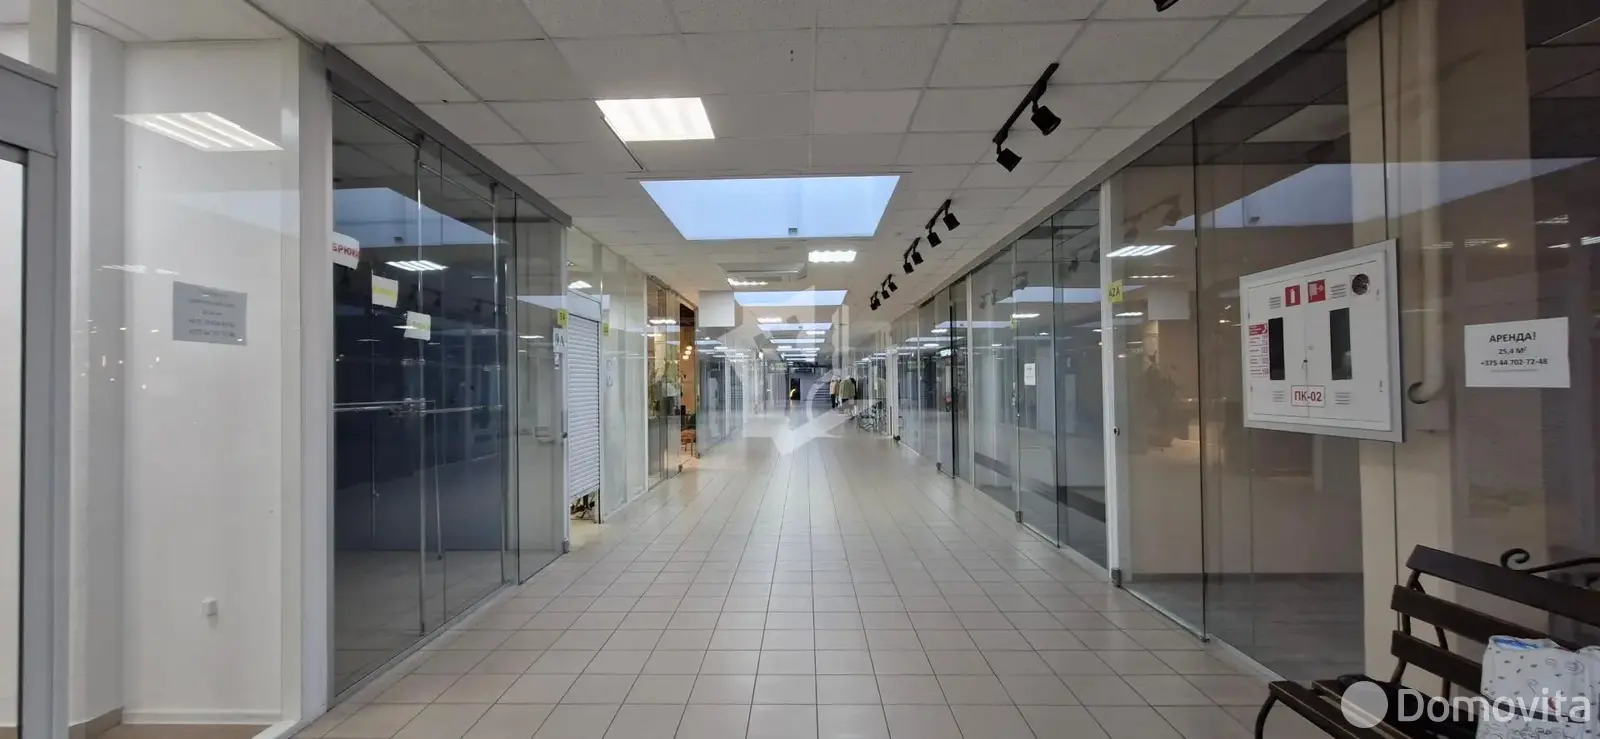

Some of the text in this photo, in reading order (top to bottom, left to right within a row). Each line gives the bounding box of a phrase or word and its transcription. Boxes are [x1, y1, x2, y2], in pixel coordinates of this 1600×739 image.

[1489, 331, 1536, 343] АРЕНДА!
[1509, 357, 1548, 366] 702-72-48
[1294, 390, 1323, 402] ПК-02
